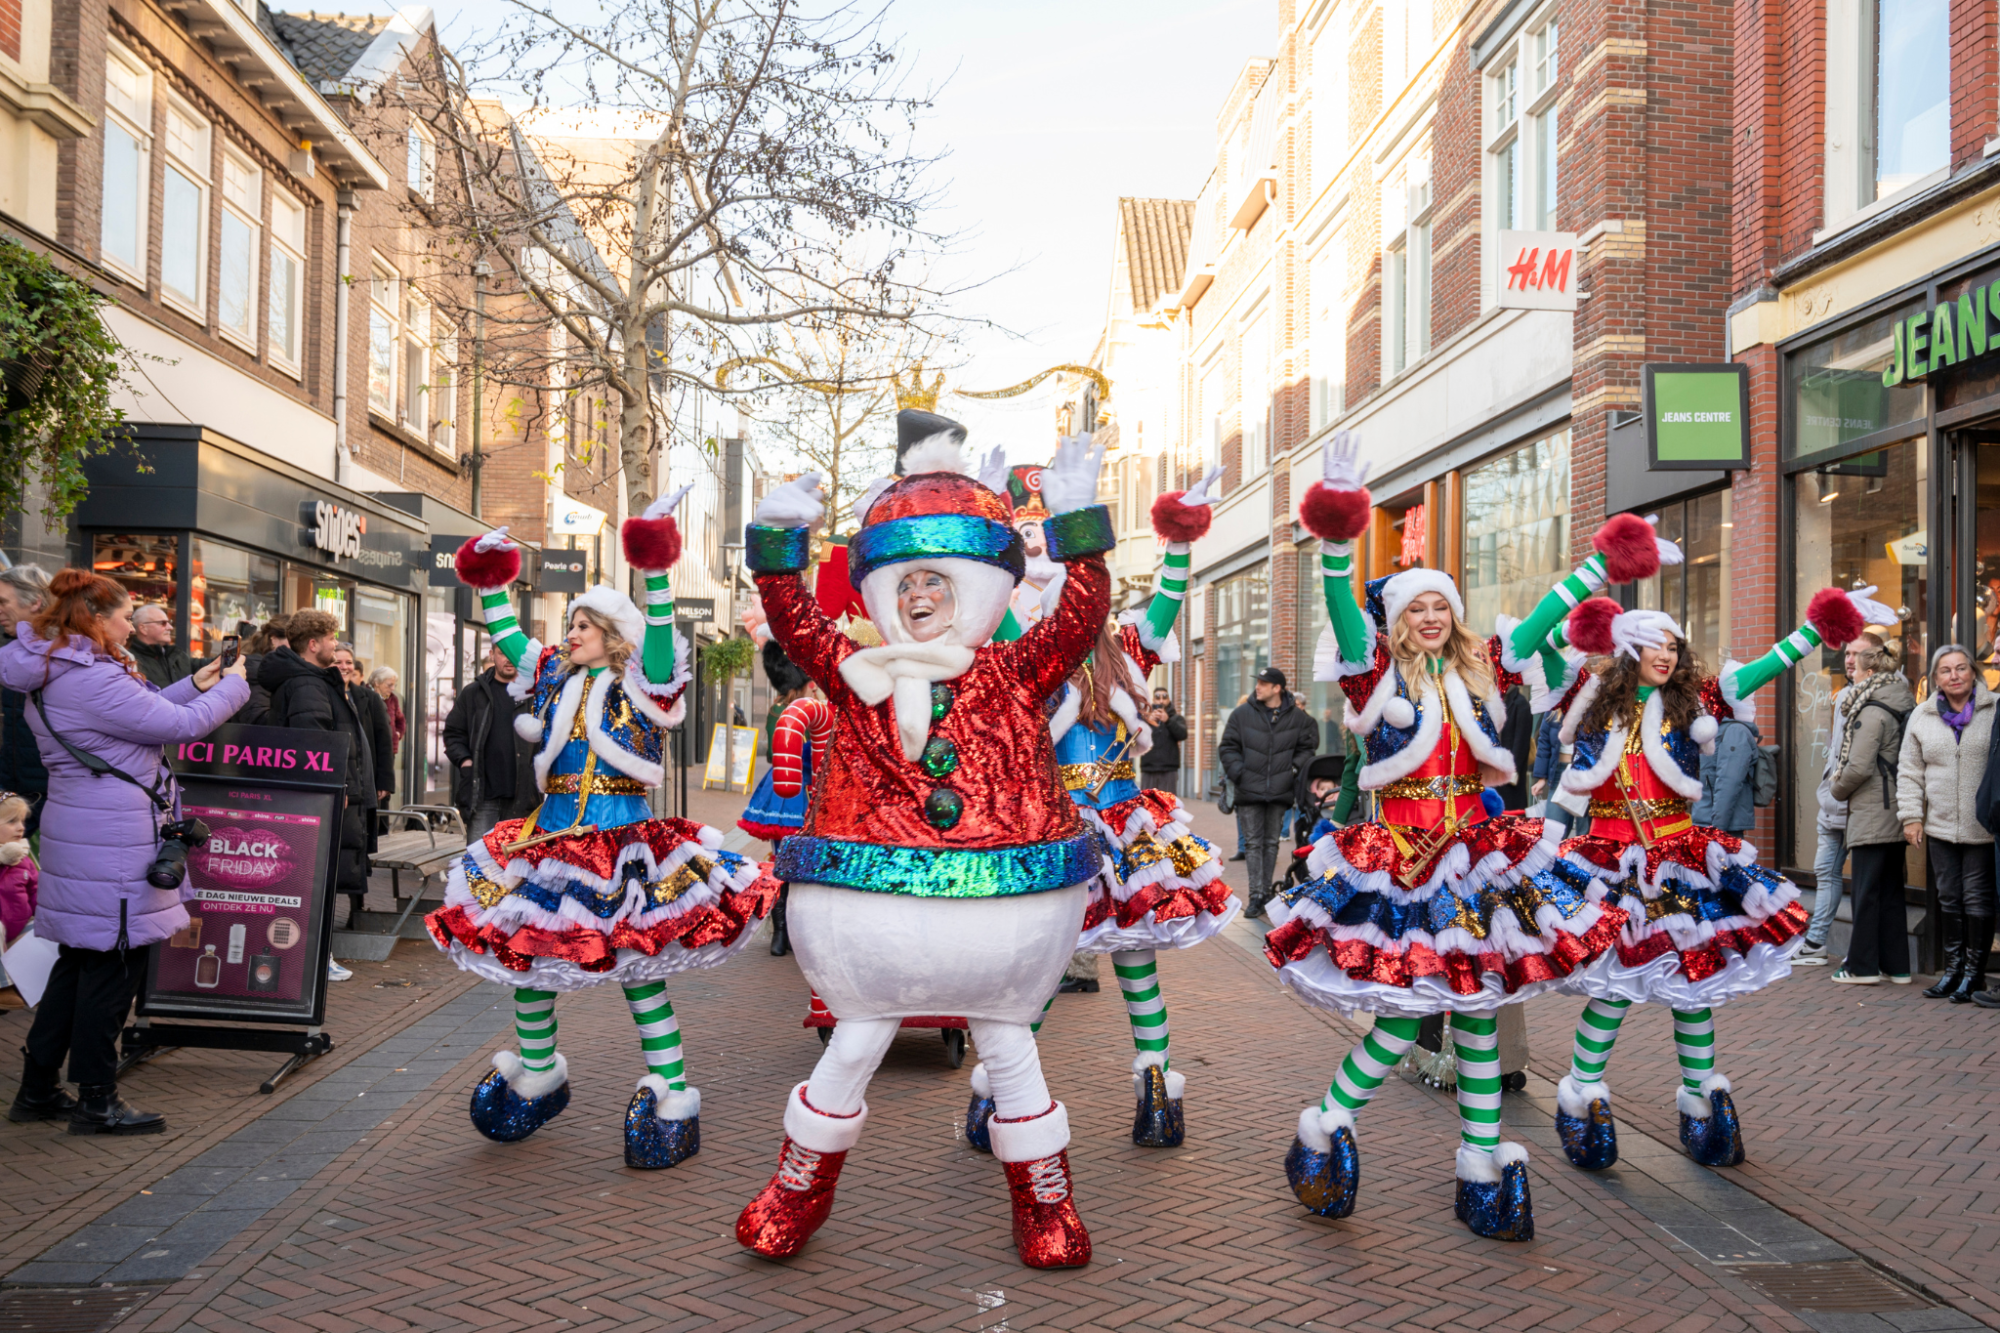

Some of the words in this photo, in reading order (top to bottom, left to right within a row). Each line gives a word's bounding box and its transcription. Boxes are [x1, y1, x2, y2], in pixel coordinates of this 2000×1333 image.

[1507, 246, 1573, 293] H&M
[1661, 412, 1692, 423] JEANS
[1694, 412, 1731, 423] CENTRE
[315, 500, 361, 564] snipes
[544, 561, 567, 570] Pearle
[677, 606, 712, 616] NELSON
[177, 741, 214, 762] ICI
[222, 744, 297, 769] PARIS
[303, 750, 334, 772] XL
[240, 791, 261, 800] PARIS
[209, 839, 279, 858] BLACK
[207, 857, 278, 877] FRIDAY
[205, 891, 226, 900] DAG
[228, 893, 266, 903] NIEUWE
[268, 896, 299, 906] DEALS
[202, 902, 242, 911] ONTDEK
[244, 904, 257, 912] ZE
[259, 905, 274, 913] NU
